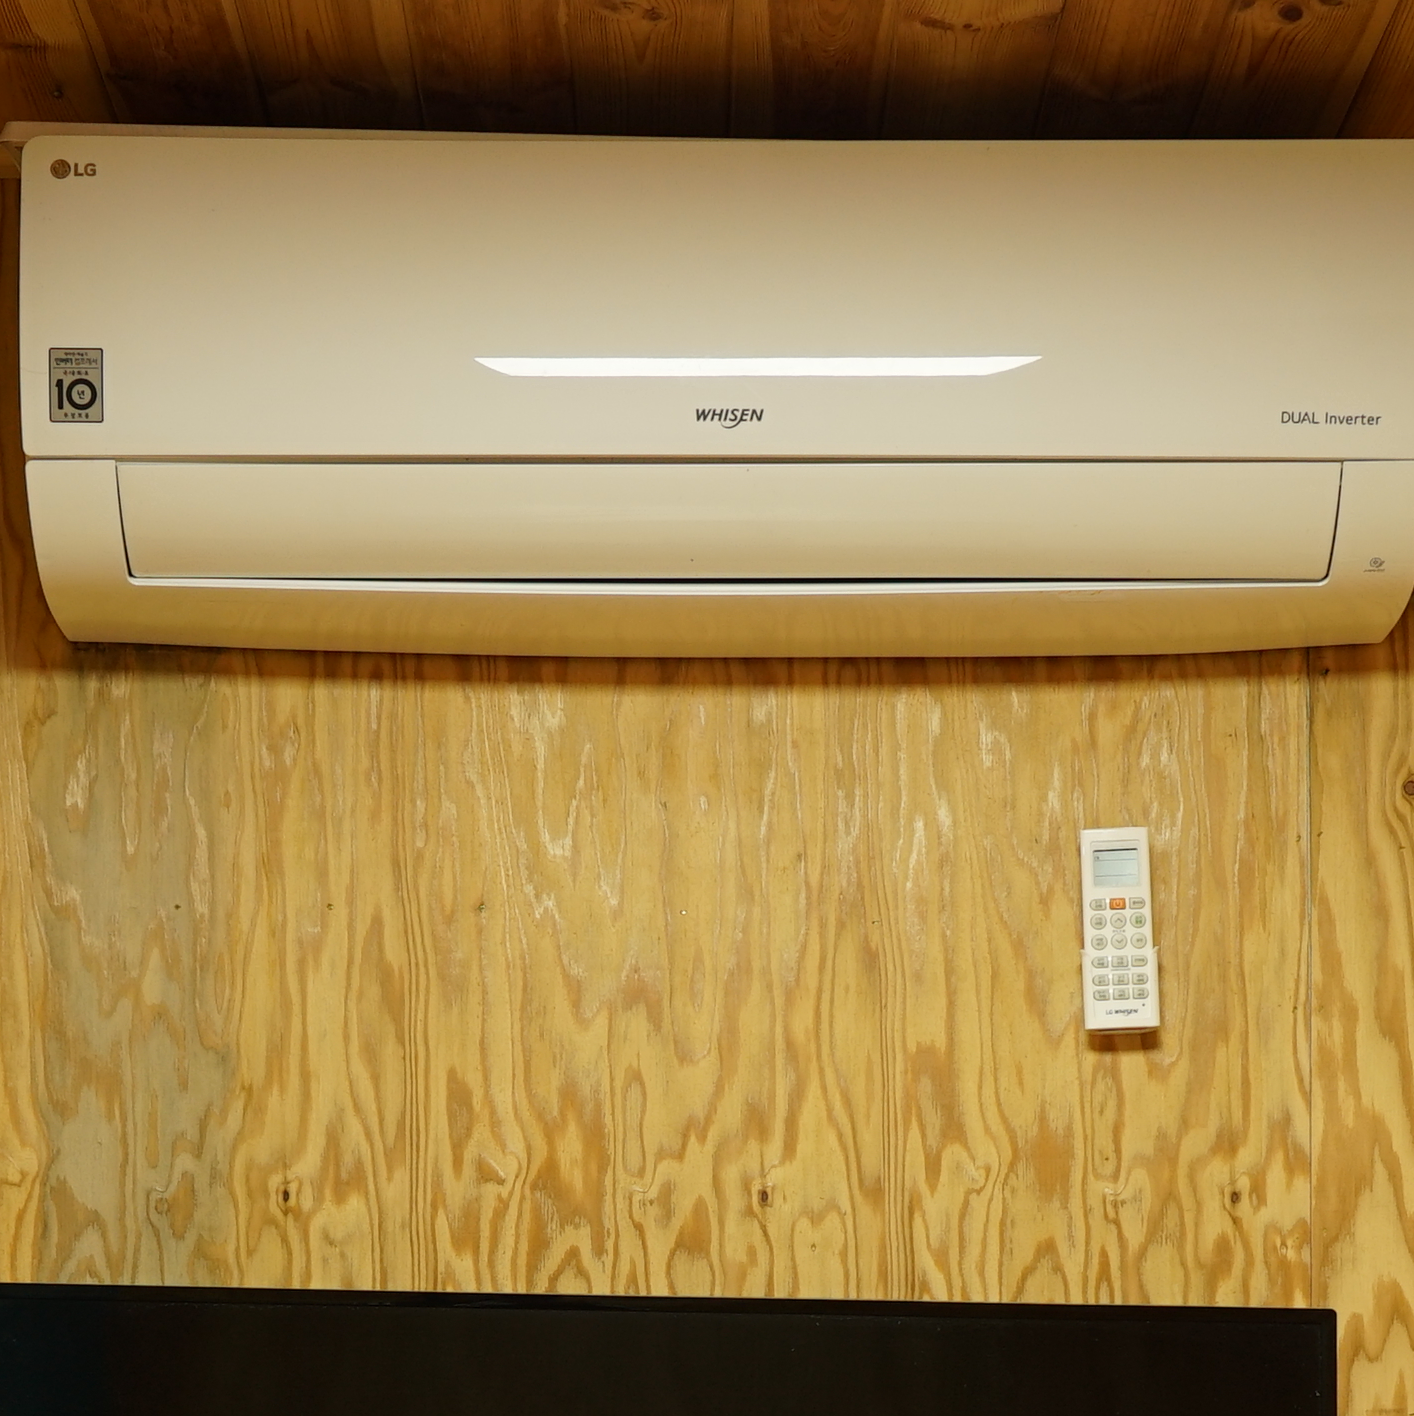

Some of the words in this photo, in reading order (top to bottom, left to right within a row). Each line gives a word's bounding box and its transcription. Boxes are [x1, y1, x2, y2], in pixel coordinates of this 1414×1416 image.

[73, 162, 97, 177] LG
[55, 378, 97, 411] 10
[695, 408, 764, 429] WHISEN
[1281, 411, 1320, 424] DUAL
[1325, 412, 1382, 425] Inverter
